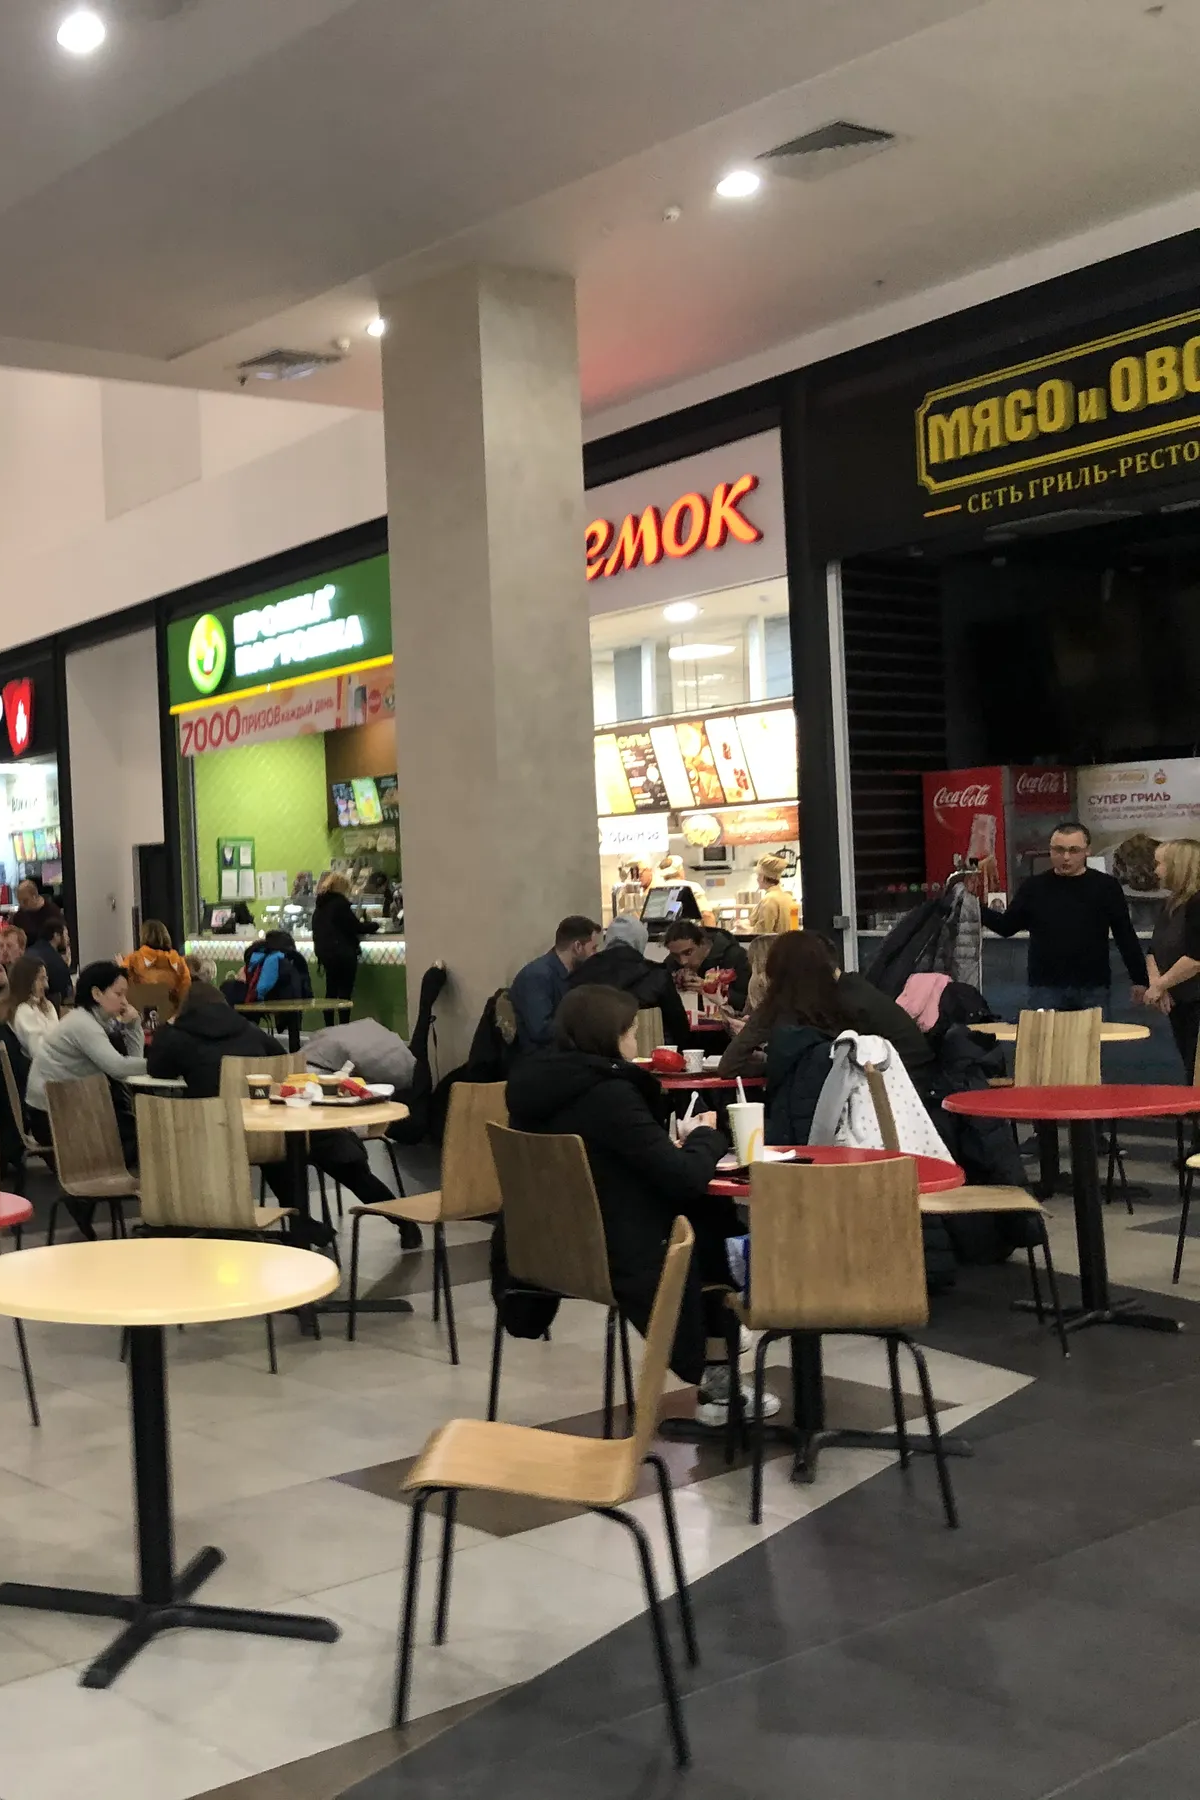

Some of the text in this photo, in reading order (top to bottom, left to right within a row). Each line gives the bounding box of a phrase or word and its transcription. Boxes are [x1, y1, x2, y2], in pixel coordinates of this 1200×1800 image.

[927, 378, 1072, 464] МЯСО
[967, 485, 1023, 513] СЕТЬ
[181, 705, 241, 757] 7000
[241, 705, 281, 735] ПРИЗОВ
[1088, 791, 1171, 805] СУПЕР ГРИЛЬ
